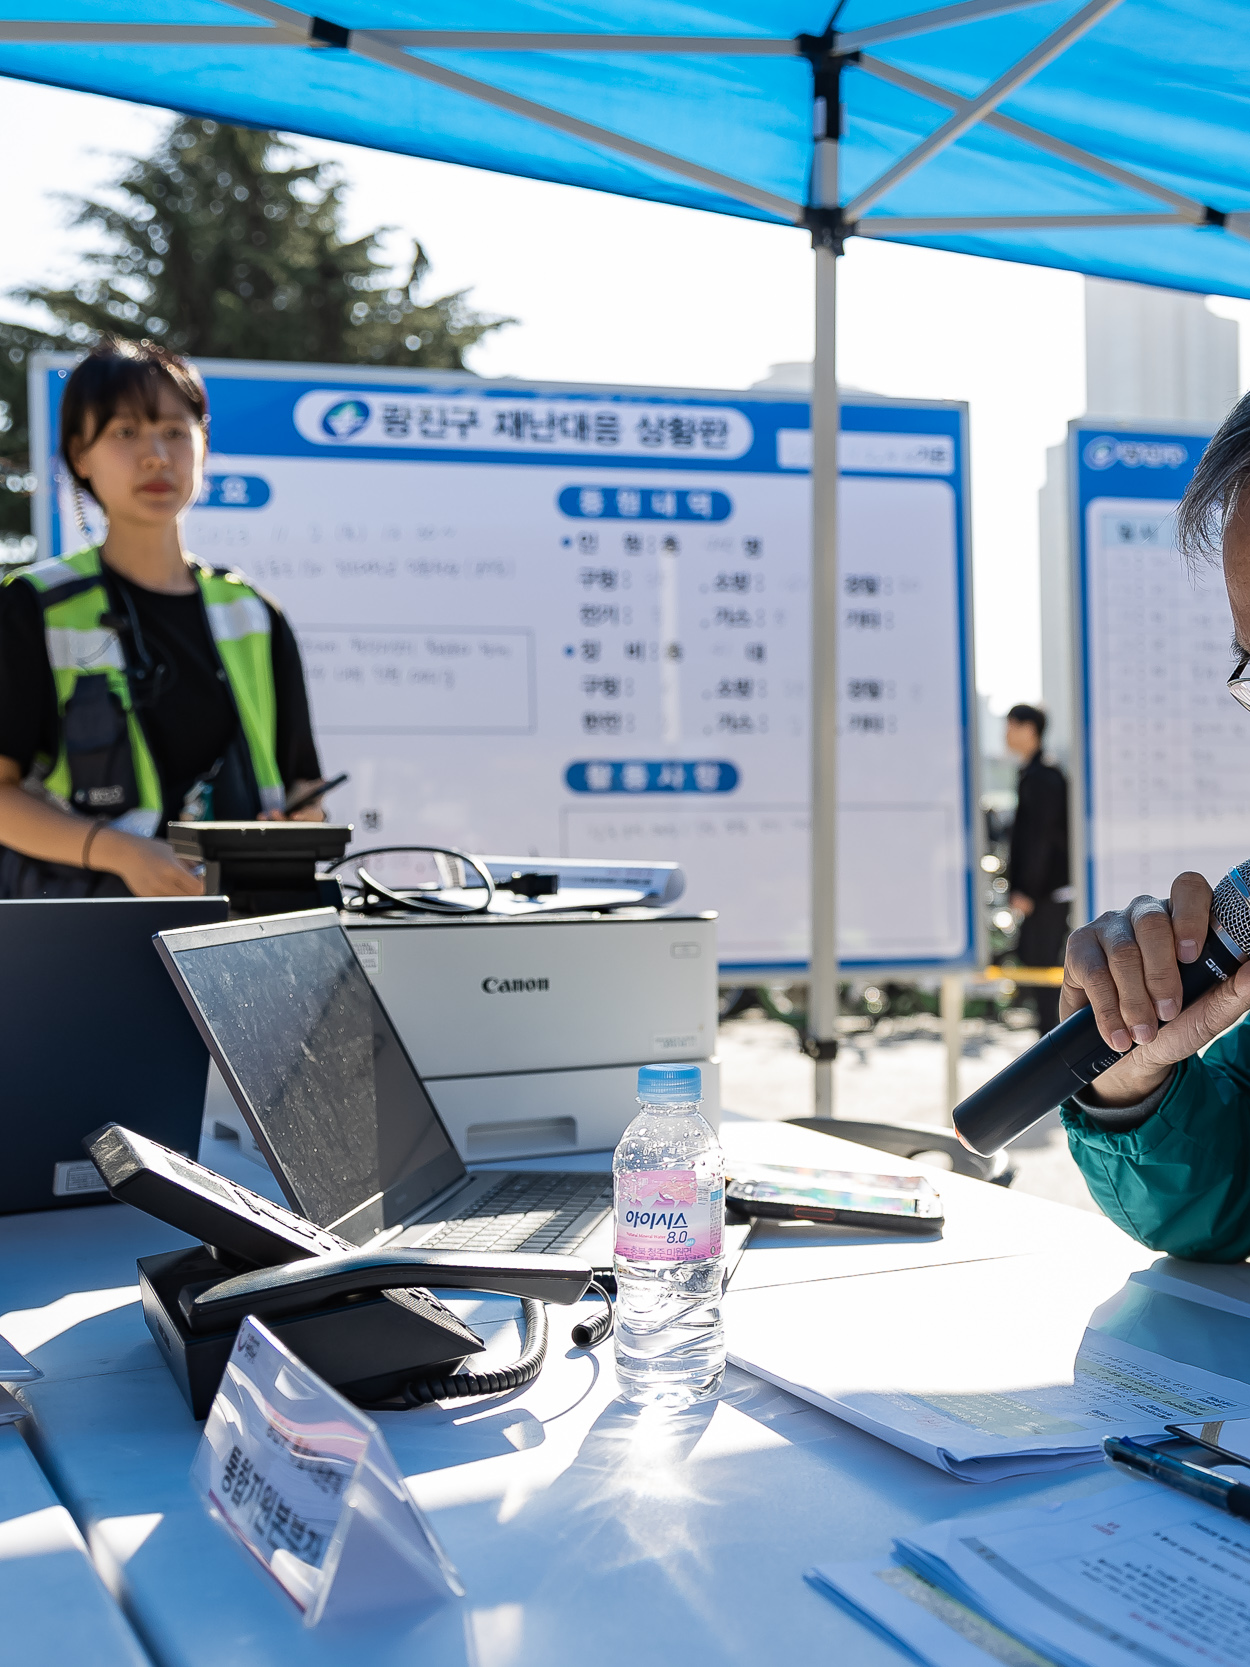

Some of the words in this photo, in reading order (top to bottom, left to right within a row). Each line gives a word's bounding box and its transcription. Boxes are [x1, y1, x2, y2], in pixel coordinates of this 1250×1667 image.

[382, 403, 479, 440] 광진구
[494, 406, 620, 446] 재난대응
[637, 412, 730, 449] 상황판
[481, 977, 550, 994] Canon
[626, 1210, 688, 1229] 아이시스
[666, 1230, 688, 1244] 8.0
